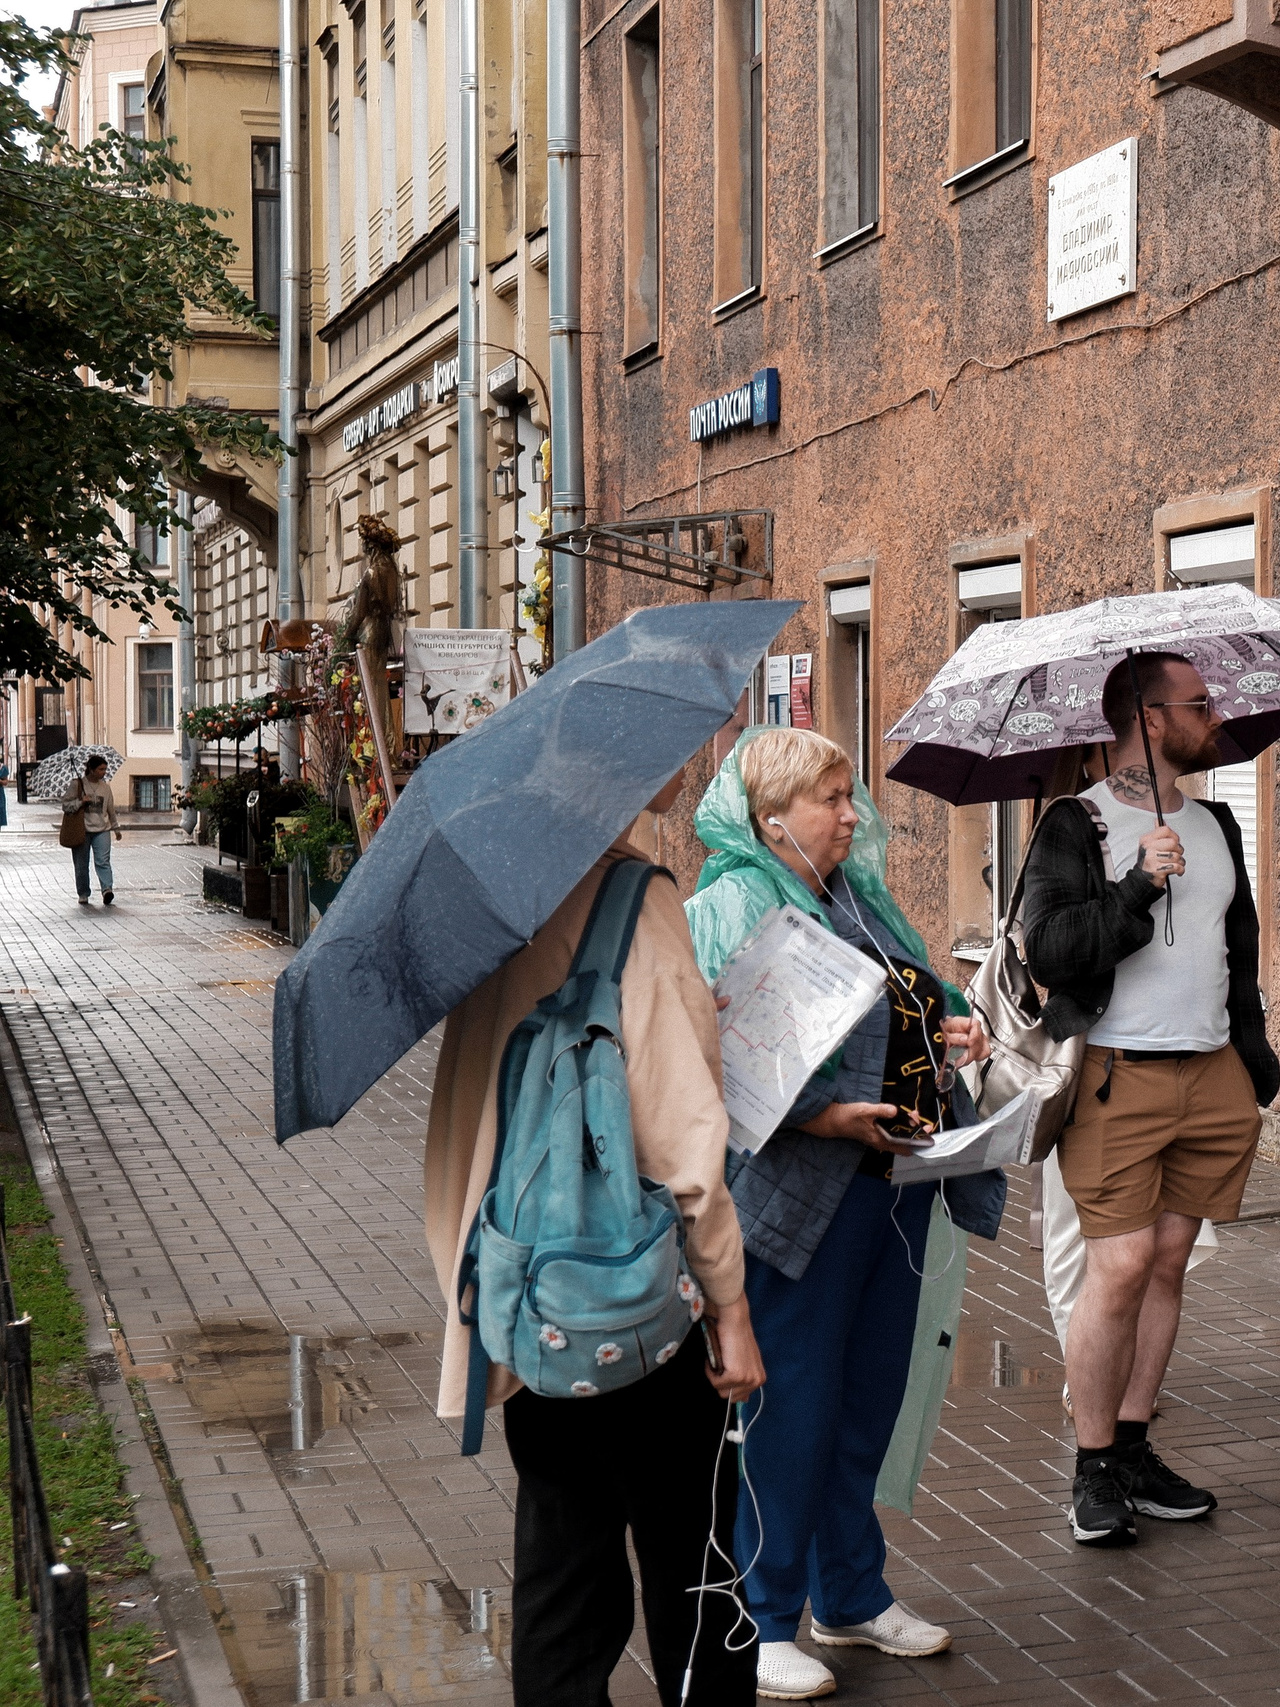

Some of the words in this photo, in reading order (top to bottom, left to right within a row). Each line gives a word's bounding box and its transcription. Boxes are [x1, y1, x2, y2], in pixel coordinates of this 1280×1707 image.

[1062, 213, 1113, 253] ВЛАДИМИР
[1056, 236, 1119, 286] МАЯКОВСКИЙ
[343, 415, 364, 452] СЕРЕБРО
[367, 405, 379, 439] АРТ
[383, 382, 414, 429] ПОДАРКИ
[689, 399, 718, 442] ПОЧТА
[718, 384, 752, 431] РОССИИ
[412, 642, 446, 650] ЛУЧШИХ
[446, 643, 504, 651] ПЕТЕРБУРГСКИХ
[413, 633, 455, 641] АВТОРСКИЕ
[457, 634, 502, 643] УКРАШЕНИЯ
